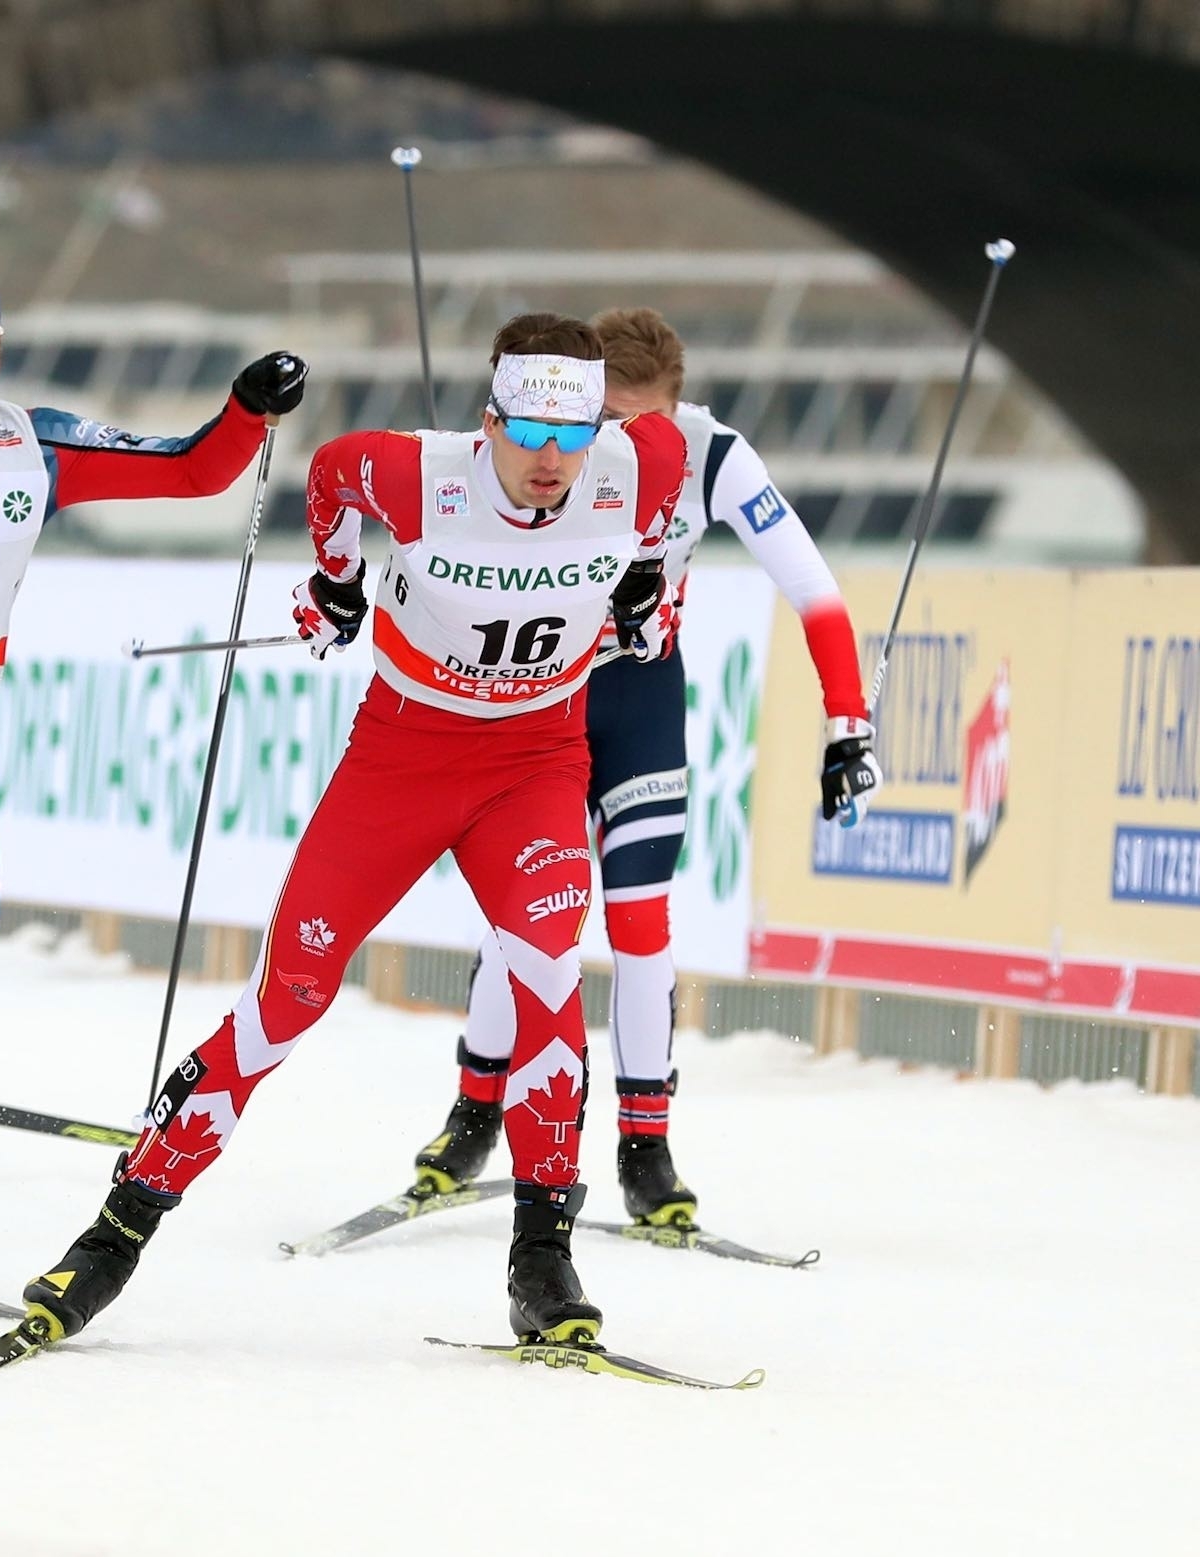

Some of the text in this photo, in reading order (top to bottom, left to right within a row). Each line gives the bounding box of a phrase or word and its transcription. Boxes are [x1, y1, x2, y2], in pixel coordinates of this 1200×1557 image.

[522, 377, 583, 393] HAYWOOD
[427, 555, 580, 592] DREWAG
[471, 616, 567, 666] 16
[444, 653, 564, 679] DRESDEN
[301, 945, 325, 957] CANADA
[101, 1203, 144, 1243] SCHER
[520, 1348, 589, 1369] FISCHER
